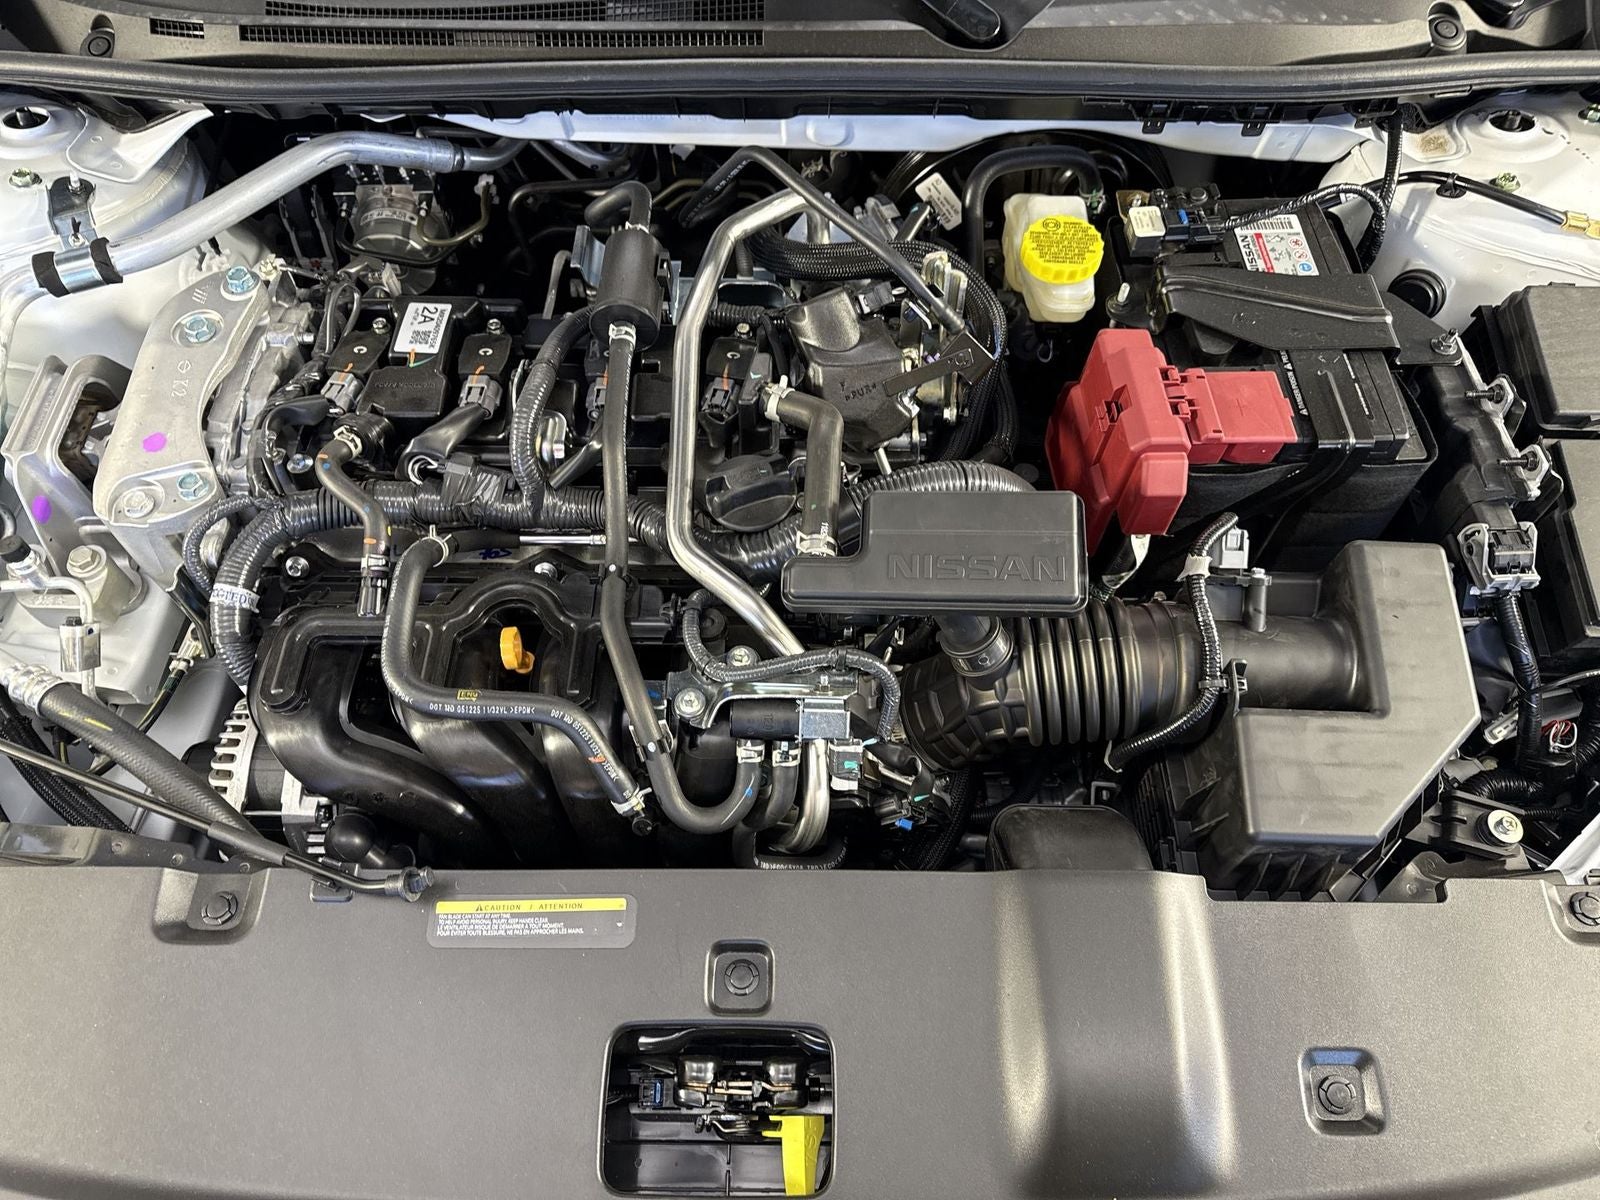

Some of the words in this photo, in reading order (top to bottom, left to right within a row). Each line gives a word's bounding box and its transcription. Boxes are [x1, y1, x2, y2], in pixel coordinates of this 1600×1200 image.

[418, 306, 439, 325] 2A
[887, 553, 1066, 582] NISSAN
[484, 904, 521, 912] CAUTION
[538, 902, 583, 910] ATTENTION
